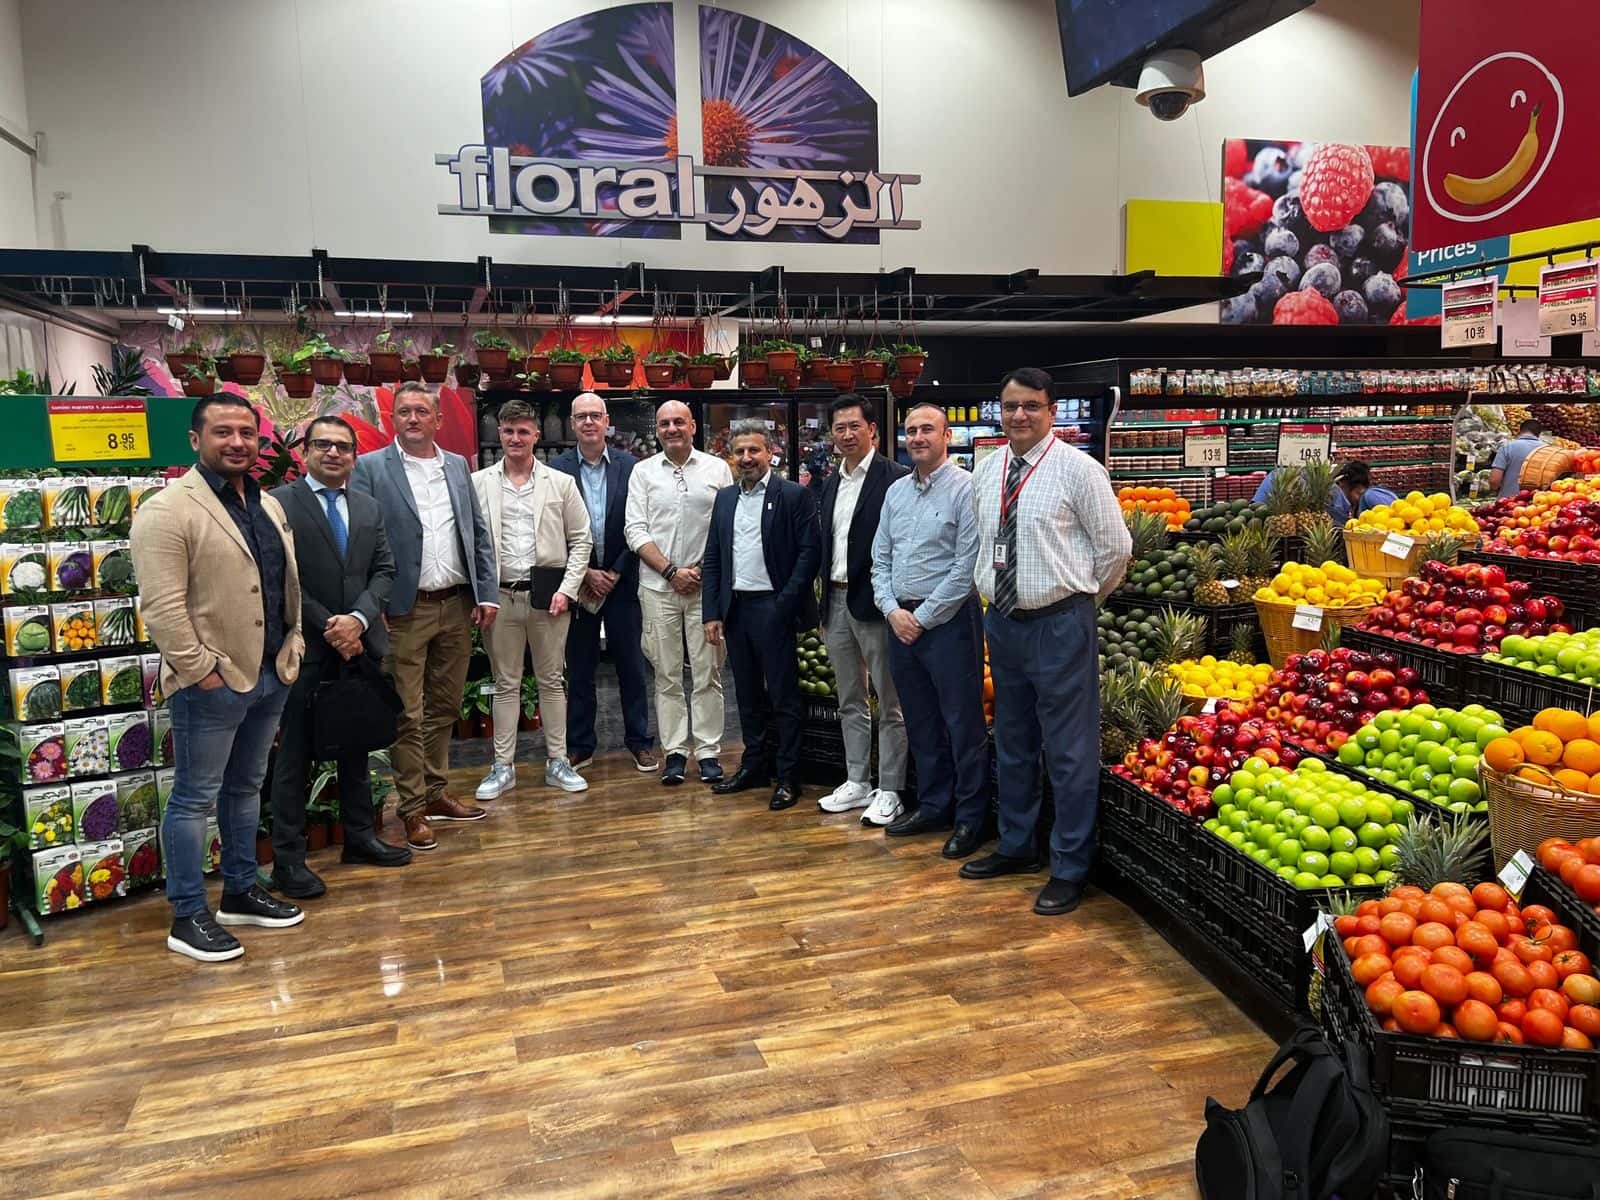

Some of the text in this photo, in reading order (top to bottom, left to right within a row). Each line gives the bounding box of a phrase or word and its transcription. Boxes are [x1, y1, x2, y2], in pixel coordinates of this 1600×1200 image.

[449, 144, 697, 218] floral
[709, 170, 904, 239] الزهور
[1417, 242, 1477, 266] Prices
